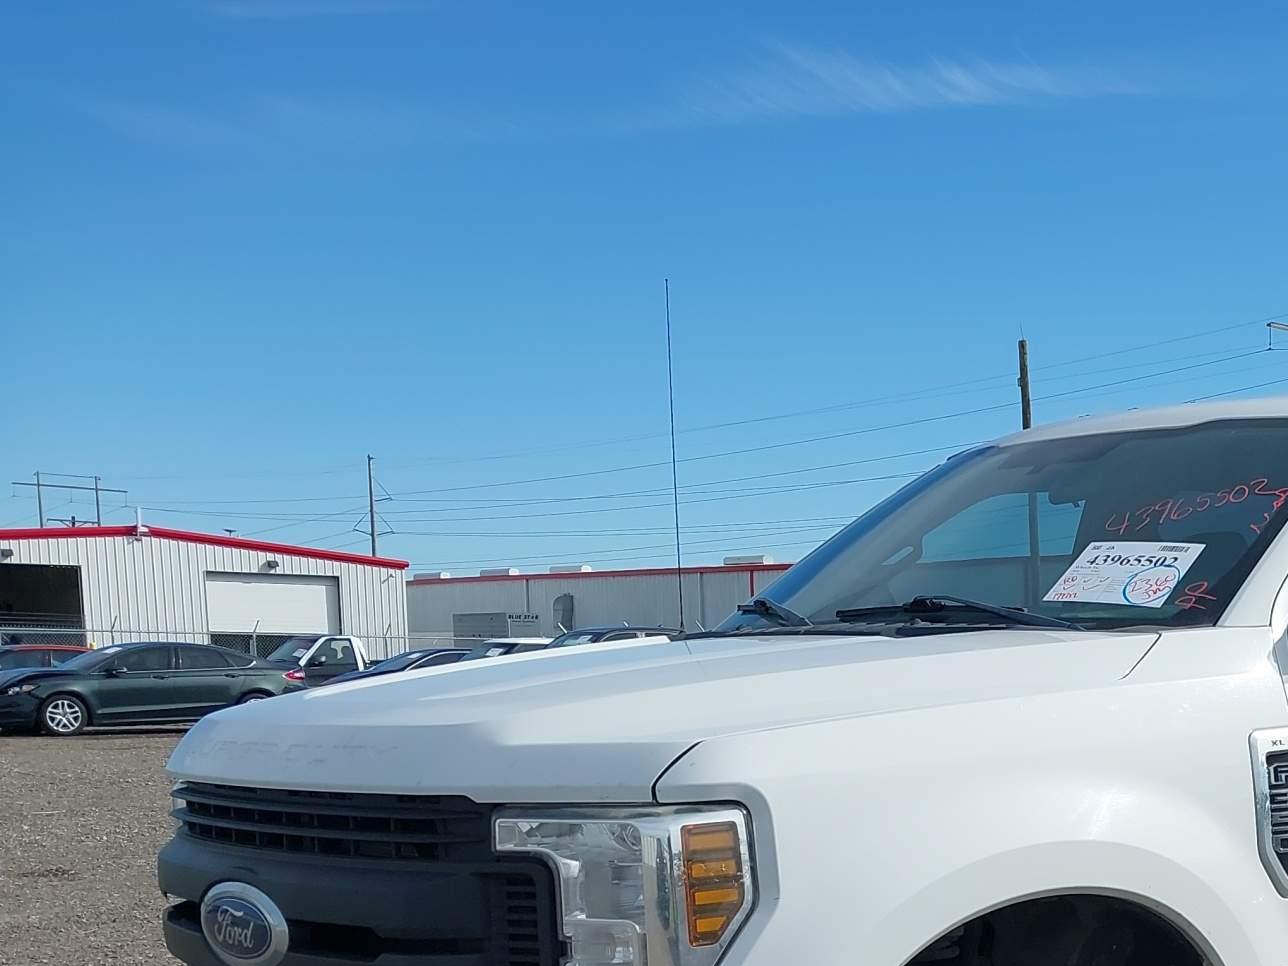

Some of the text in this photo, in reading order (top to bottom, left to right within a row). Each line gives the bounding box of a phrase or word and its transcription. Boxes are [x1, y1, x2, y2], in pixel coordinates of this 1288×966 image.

[1105, 478, 1278, 535] 43965502
[1086, 553, 1179, 568] 43965502
[1271, 739, 1285, 747] XL
[214, 904, 255, 948] Ford
